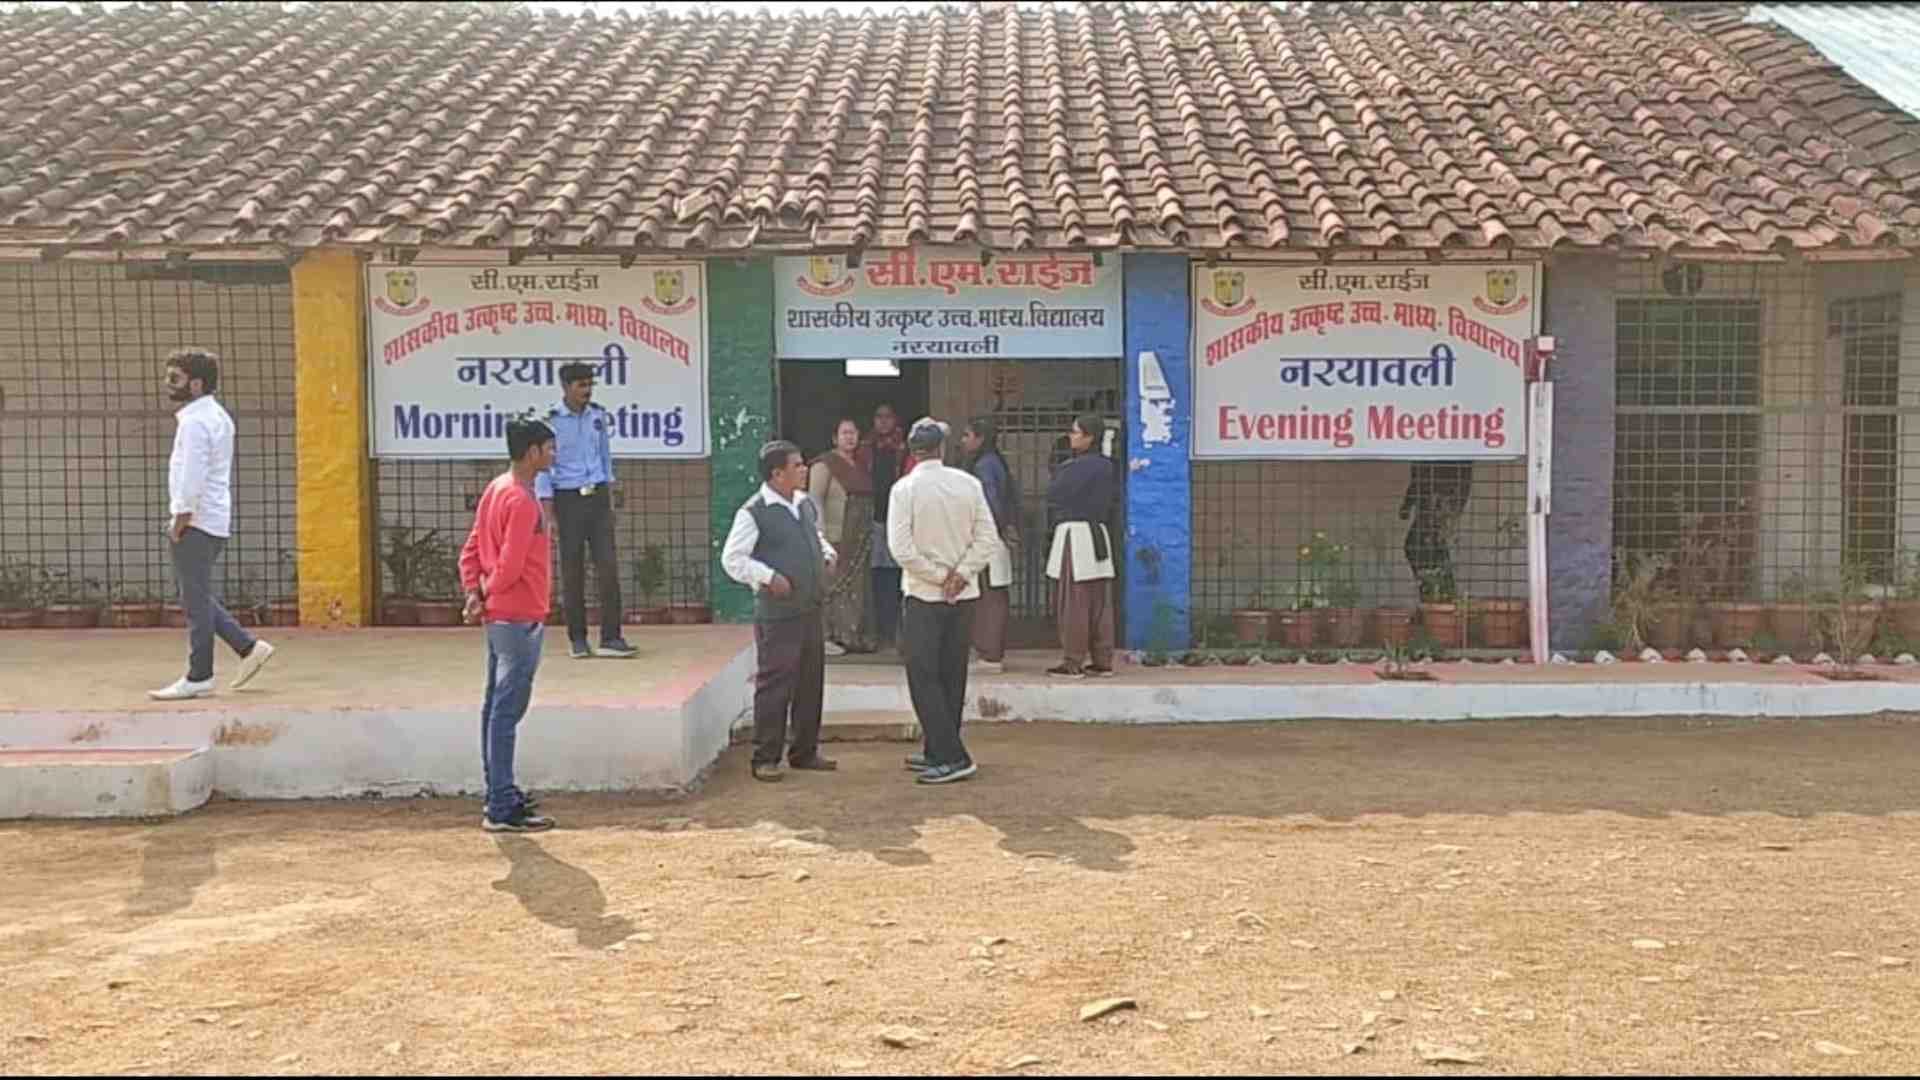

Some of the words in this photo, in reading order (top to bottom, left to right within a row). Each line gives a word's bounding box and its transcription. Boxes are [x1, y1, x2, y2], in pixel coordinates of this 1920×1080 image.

[384, 312, 459, 365] शासकीय
[465, 303, 517, 334] उत्कृष्ट
[619, 305, 690, 366] विद्यालय
[787, 302, 870, 328] शासकीय
[875, 309, 934, 336] उत्कृष्ट
[1206, 312, 1284, 366] शासकीय
[1290, 302, 1343, 335] उत्कृष्ट
[1448, 305, 1521, 367] विद्यालय
[456, 343, 629, 386] नरयाली
[892, 335, 999, 354] नरयावली
[1280, 343, 1456, 387] नरयावली
[394, 404, 536, 439] Mornin
[606, 403, 684, 447] eting
[1218, 405, 1354, 448] Evening
[1368, 404, 1505, 448] Meeting
